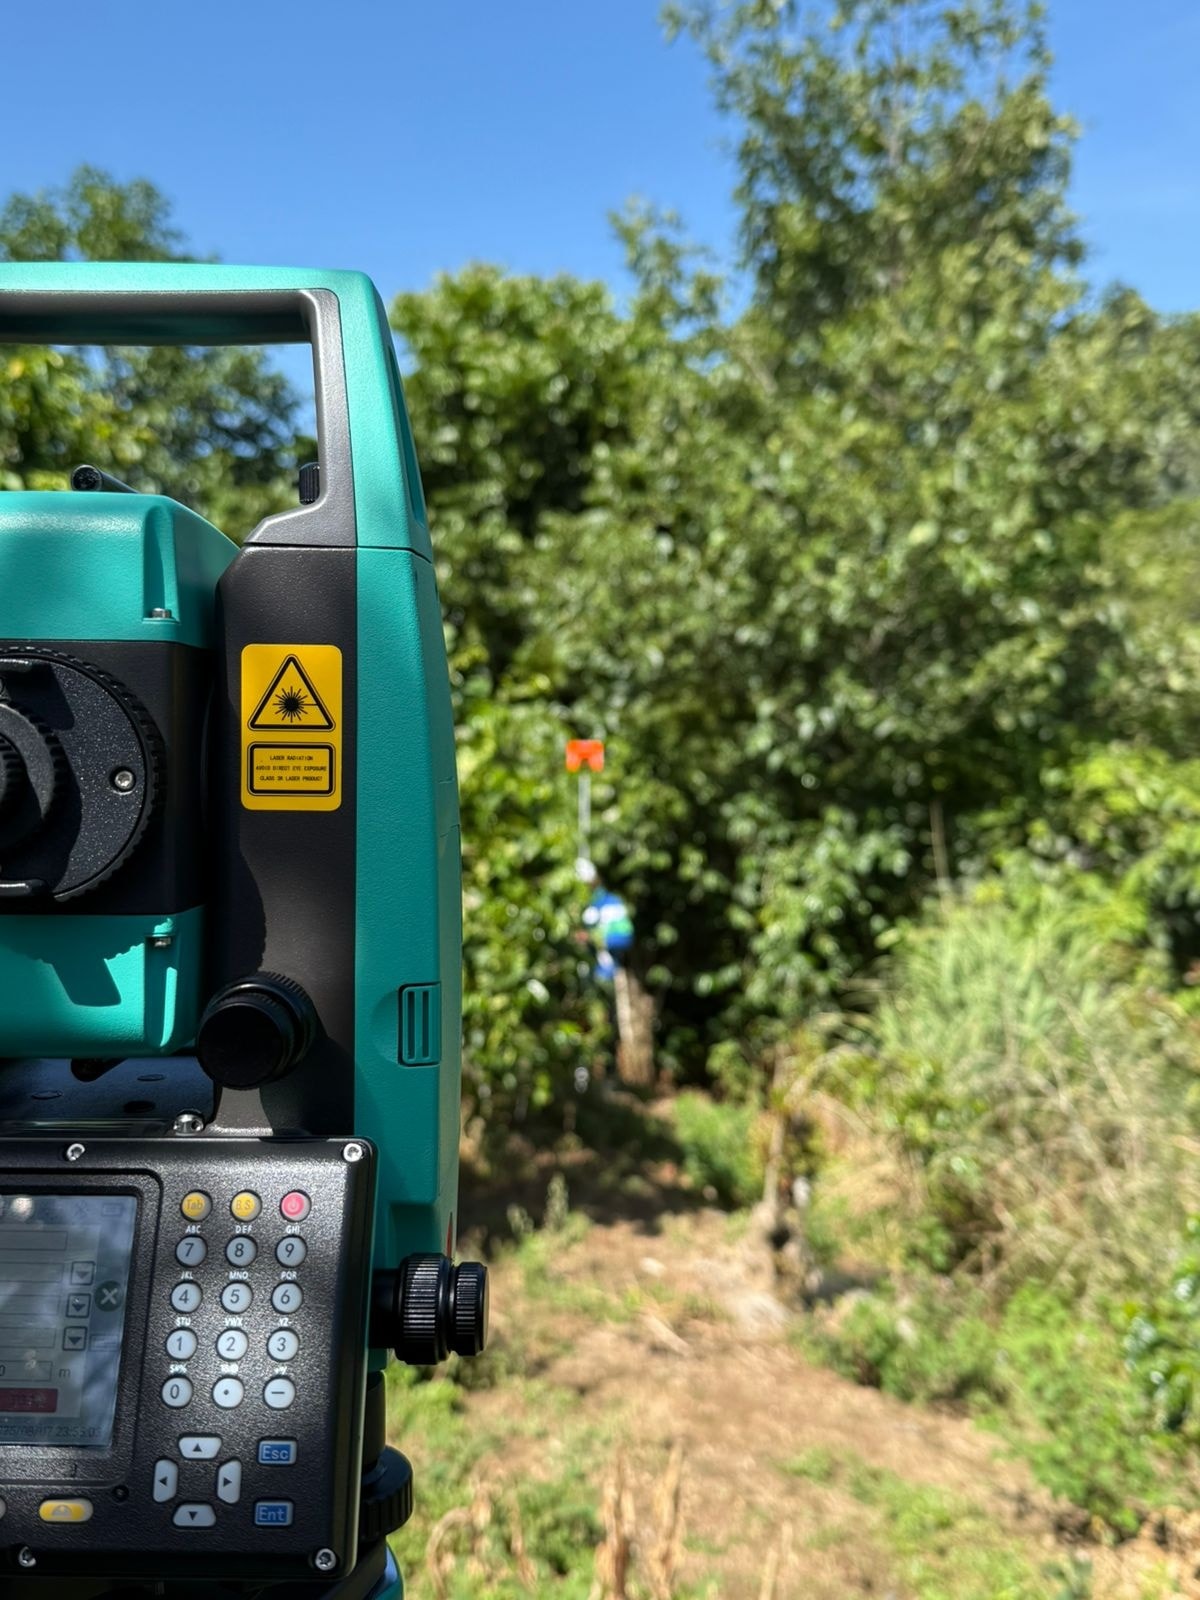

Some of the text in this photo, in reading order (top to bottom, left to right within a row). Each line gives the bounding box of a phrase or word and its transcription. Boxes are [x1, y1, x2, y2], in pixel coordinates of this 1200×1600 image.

[187, 1199, 203, 1210] Tab
[185, 1225, 201, 1233] ABC
[235, 1225, 253, 1233] DEF
[286, 1225, 300, 1233] GHI
[185, 1243, 194, 1257] 7
[234, 1243, 244, 1257] 8
[285, 1243, 295, 1258] 9
[181, 1271, 194, 1279] JKL
[229, 1271, 249, 1279] MNO
[280, 1271, 297, 1279] PQR
[178, 1289, 189, 1304] 4
[230, 1289, 240, 1304] 5
[280, 1289, 290, 1304] 6
[176, 1316, 191, 1326] STU
[225, 1317, 243, 1326] VWX
[176, 1336, 183, 1351] 1
[226, 1336, 236, 1351] 2
[276, 1337, 286, 1352] 3
[59, 1368, 71, 1378] m
[170, 1384, 180, 1399] 0
[262, 1445, 289, 1460] Esc
[259, 1507, 285, 1521] Ent
